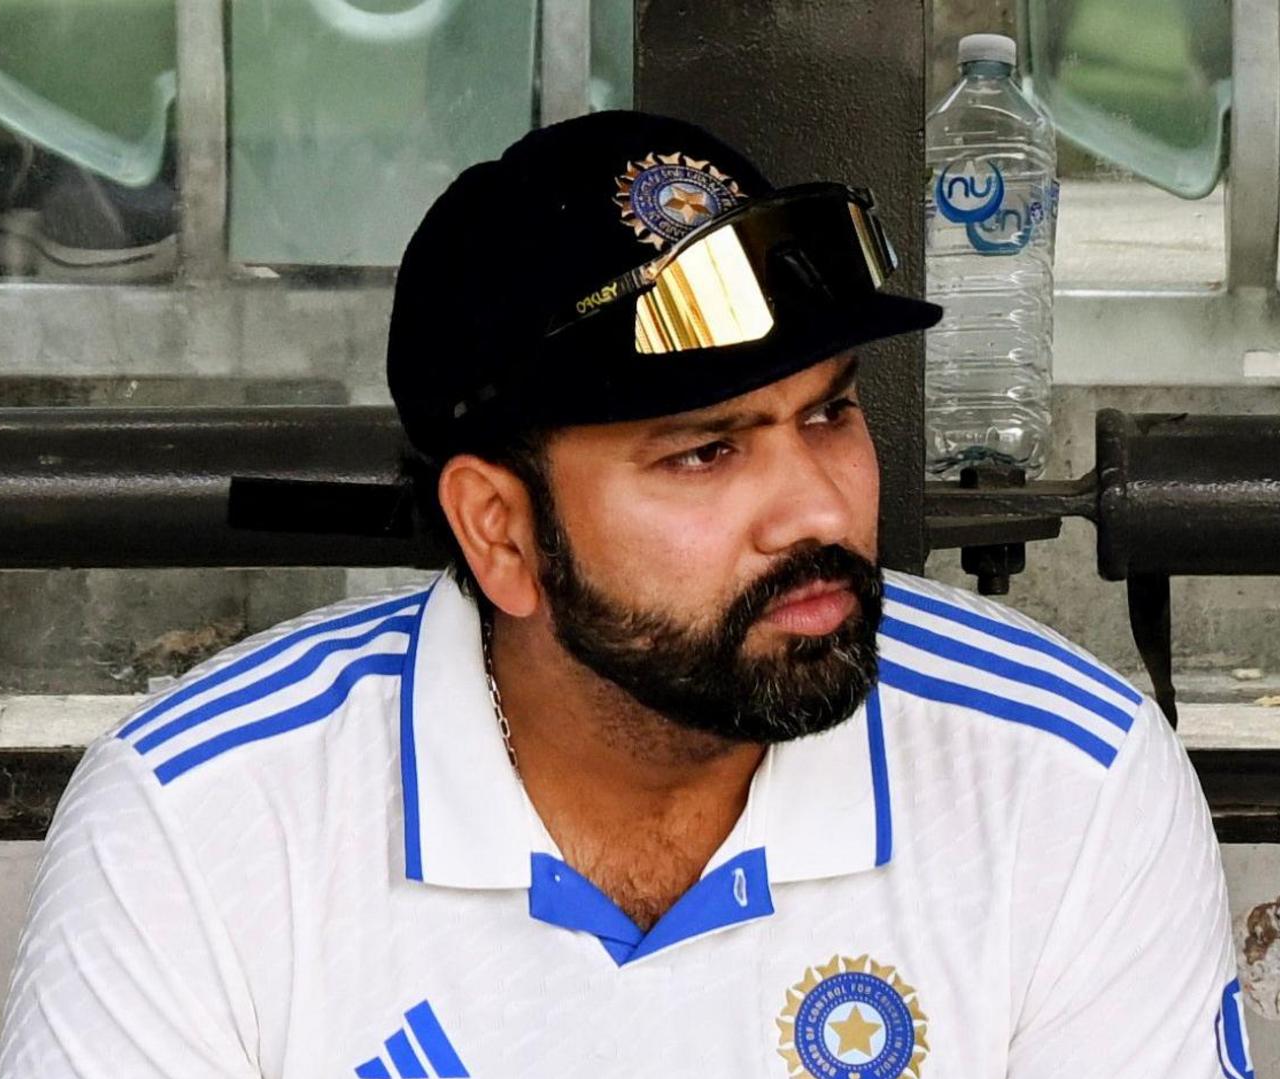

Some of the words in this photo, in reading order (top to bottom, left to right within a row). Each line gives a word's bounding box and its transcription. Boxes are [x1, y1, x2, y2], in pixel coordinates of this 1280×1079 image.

[947, 176, 993, 199] nu
[576, 281, 618, 314] OAKLEY
[850, 983, 873, 996] FOR
[807, 984, 848, 1024] CONTROL
[805, 1026, 816, 1042] OF
[807, 1043, 838, 1078] BOARD
[873, 1051, 900, 1078] INDIA
